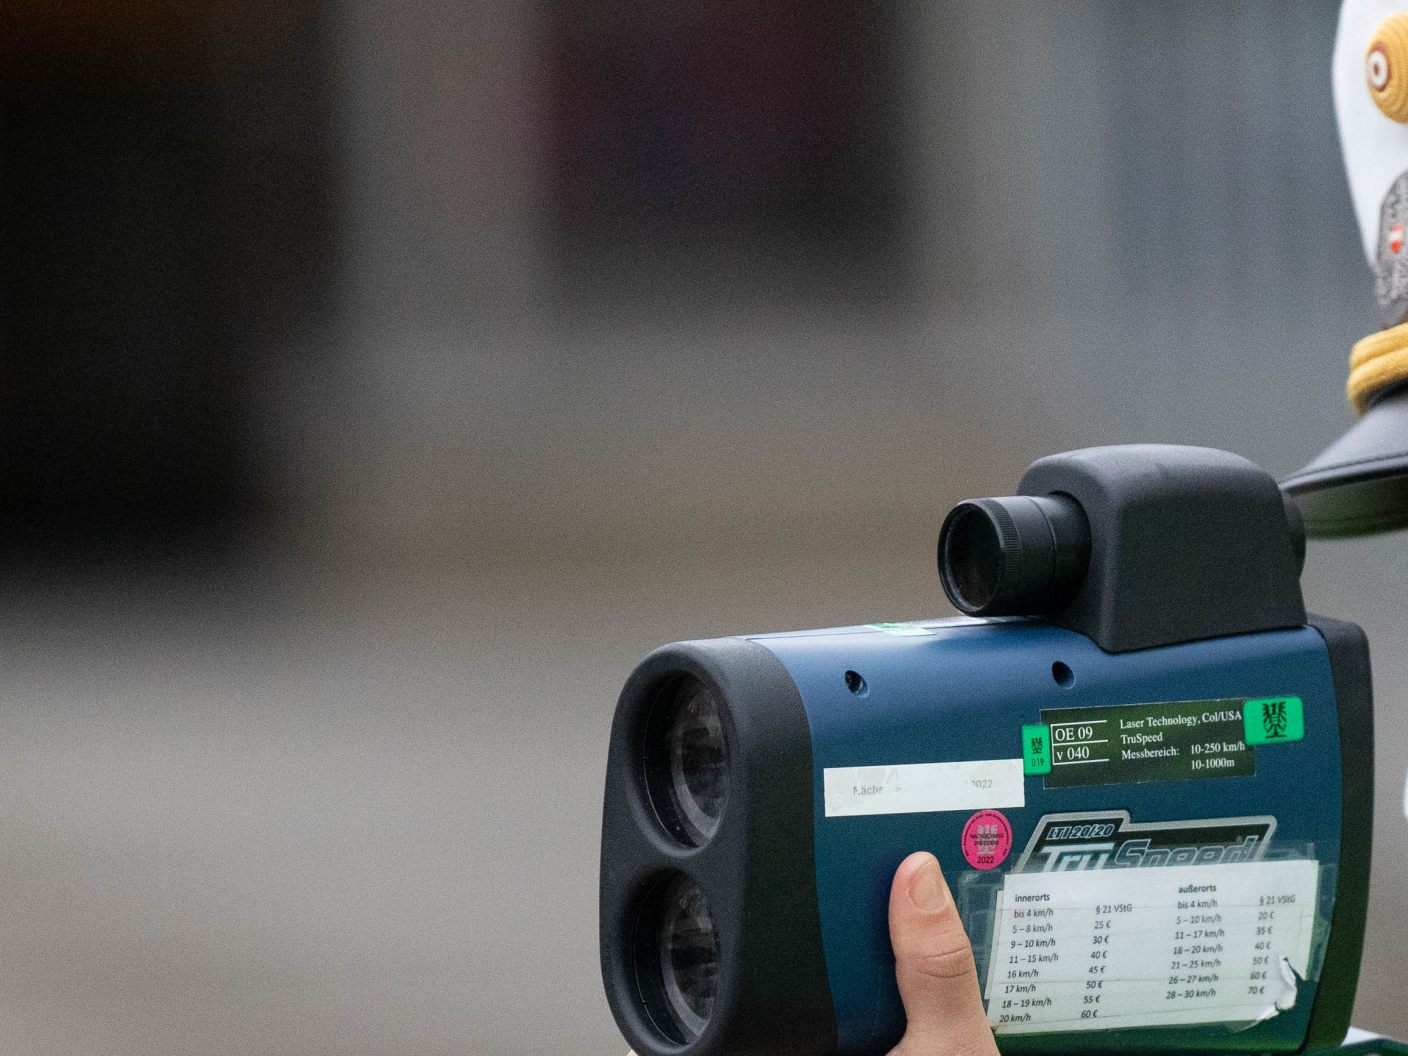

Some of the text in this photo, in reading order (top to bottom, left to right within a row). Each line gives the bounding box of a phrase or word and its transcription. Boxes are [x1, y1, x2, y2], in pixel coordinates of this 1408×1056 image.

[1120, 710, 1242, 729] Laser Technology, Col/USA
[1055, 727, 1093, 741] OE 09
[1121, 732, 1163, 745] TruSpeed
[1056, 747, 1090, 760] v 040
[1121, 740, 1246, 760] Messbereich: 10-250 km/h
[1191, 758, 1235, 770] 10-1000m
[1046, 824, 1115, 840] LTI 20/20
[1178, 884, 1216, 894] außerorts
[1015, 894, 1050, 902] innerorts
[1198, 900, 1218, 908] km/h
[1259, 896, 1264, 906] §
[1267, 896, 1275, 904] 21
[1277, 895, 1296, 904] VStG
[1014, 910, 1024, 918] bis
[1034, 908, 1053, 917] km/h
[1096, 905, 1100, 915] §
[1103, 905, 1111, 913] 21
[1114, 904, 1132, 913] VStG
[1191, 916, 1200, 924] 10
[1202, 915, 1222, 923] km/h
[1258, 912, 1268, 920] 20
[1269, 911, 1274, 919] €
[1033, 924, 1053, 933] km/h
[1094, 921, 1104, 929] 25
[1175, 932, 1184, 940] 11
[1194, 931, 1203, 939] 17
[1204, 929, 1225, 938] km/h
[1268, 926, 1272, 934] €
[1025, 940, 1034, 948] 10
[1036, 939, 1056, 948] km/h
[1173, 947, 1183, 955] 18
[1192, 946, 1200, 954] 20
[1203, 944, 1223, 953] km/h
[1255, 942, 1264, 950] 40
[1009, 956, 1018, 964] 11
[1028, 955, 1037, 963] 15
[1039, 954, 1058, 963] km/h
[1103, 951, 1108, 959] €
[1171, 962, 1180, 970] 21
[1189, 961, 1198, 969] 25
[1201, 960, 1221, 968] km/h
[1253, 957, 1263, 965] 50
[1264, 957, 1269, 965] €
[1019, 969, 1039, 978] km/h
[1089, 966, 1098, 974] 45
[1101, 966, 1105, 974] €
[1169, 977, 1178, 985] 26
[1198, 974, 1219, 983] km/h
[1251, 972, 1261, 980] 60
[1262, 971, 1267, 979] €
[1016, 984, 1036, 993] km/h
[1086, 981, 1096, 989] 50
[1166, 992, 1176, 1000] 28
[1185, 990, 1194, 998] 30
[1196, 989, 1216, 998] km/h
[1260, 986, 1265, 994] €
[1021, 1000, 1029, 1008] 19
[1031, 998, 1052, 1007] km/h
[1083, 996, 1093, 1004] 55
[1095, 995, 1100, 1003] €
[1000, 1010, 1098, 1023] 20 km/h 60 €
